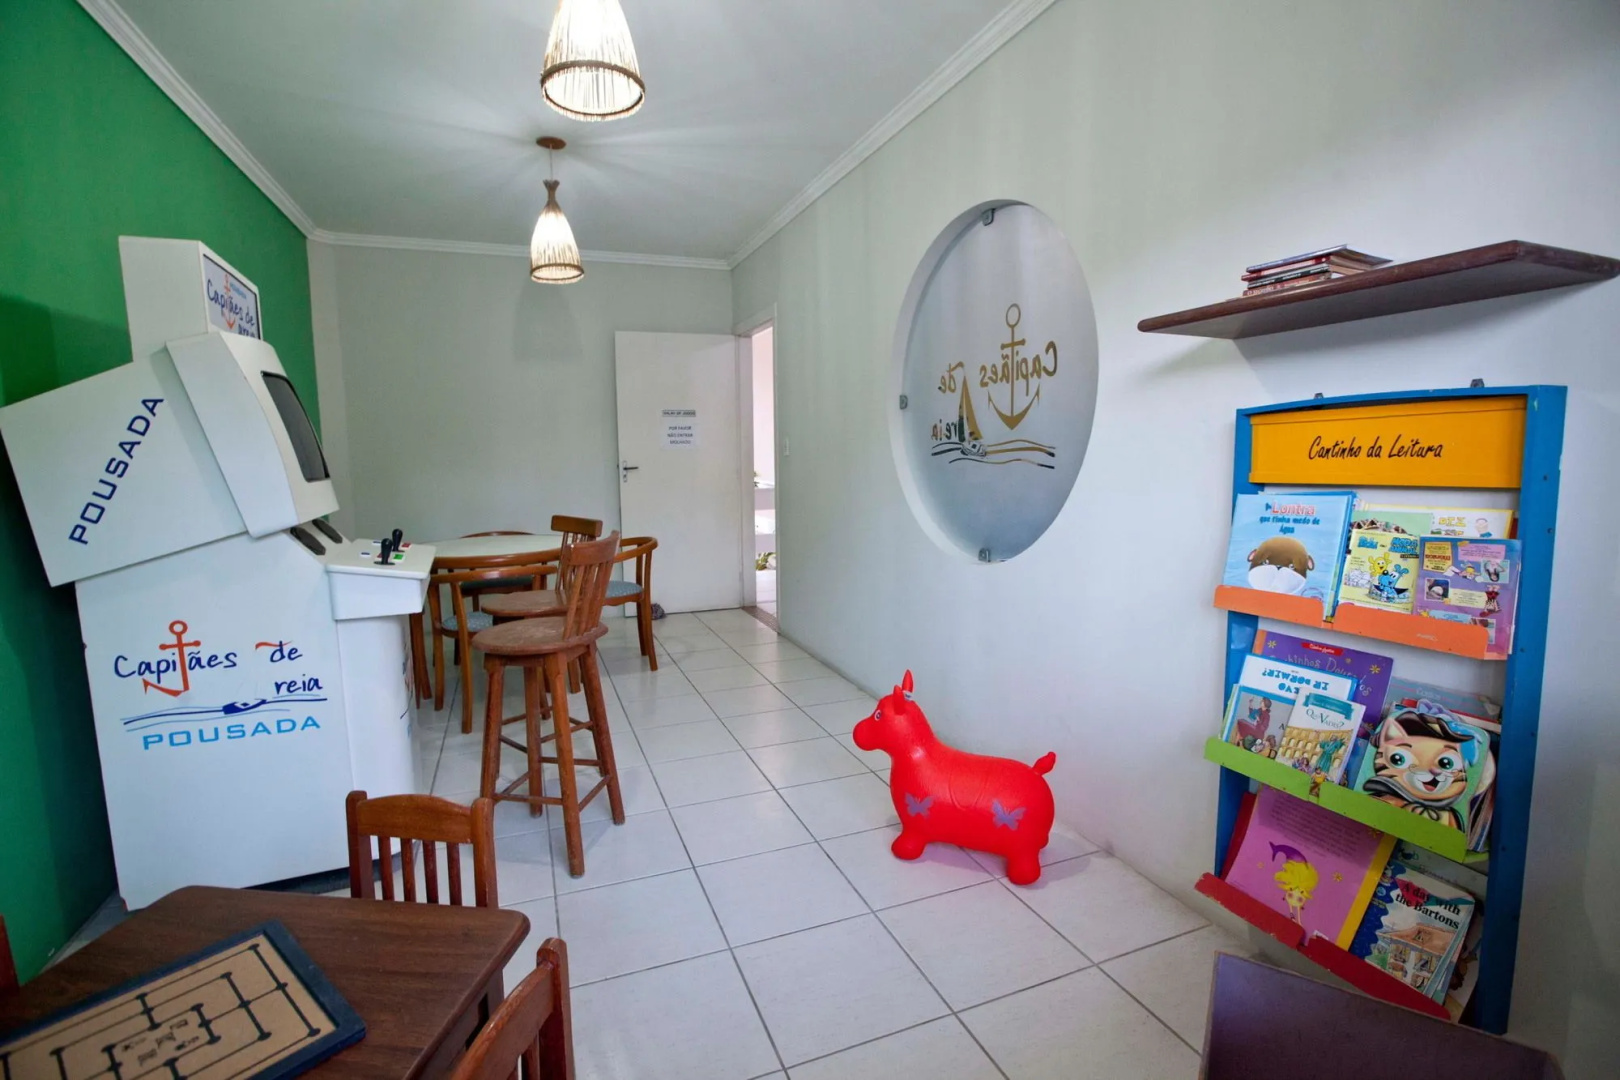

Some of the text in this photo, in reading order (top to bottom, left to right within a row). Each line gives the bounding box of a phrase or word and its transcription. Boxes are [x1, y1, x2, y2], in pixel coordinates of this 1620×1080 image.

[1308, 434, 1443, 460] Cantinho da Leitura
[68, 397, 164, 545] POUSADA
[1271, 501, 1316, 515] Lontra
[1260, 516, 1320, 525] que tinha medo de
[269, 641, 303, 663] de
[275, 674, 323, 695] reia
[1262, 668, 1330, 691] IR DORMIR?
[1278, 682, 1299, 695] EVO
[143, 716, 321, 751] POUSADA
[1403, 883, 1461, 916] A day with
[1395, 893, 1411, 907] the
[1414, 901, 1460, 930] Bartons
